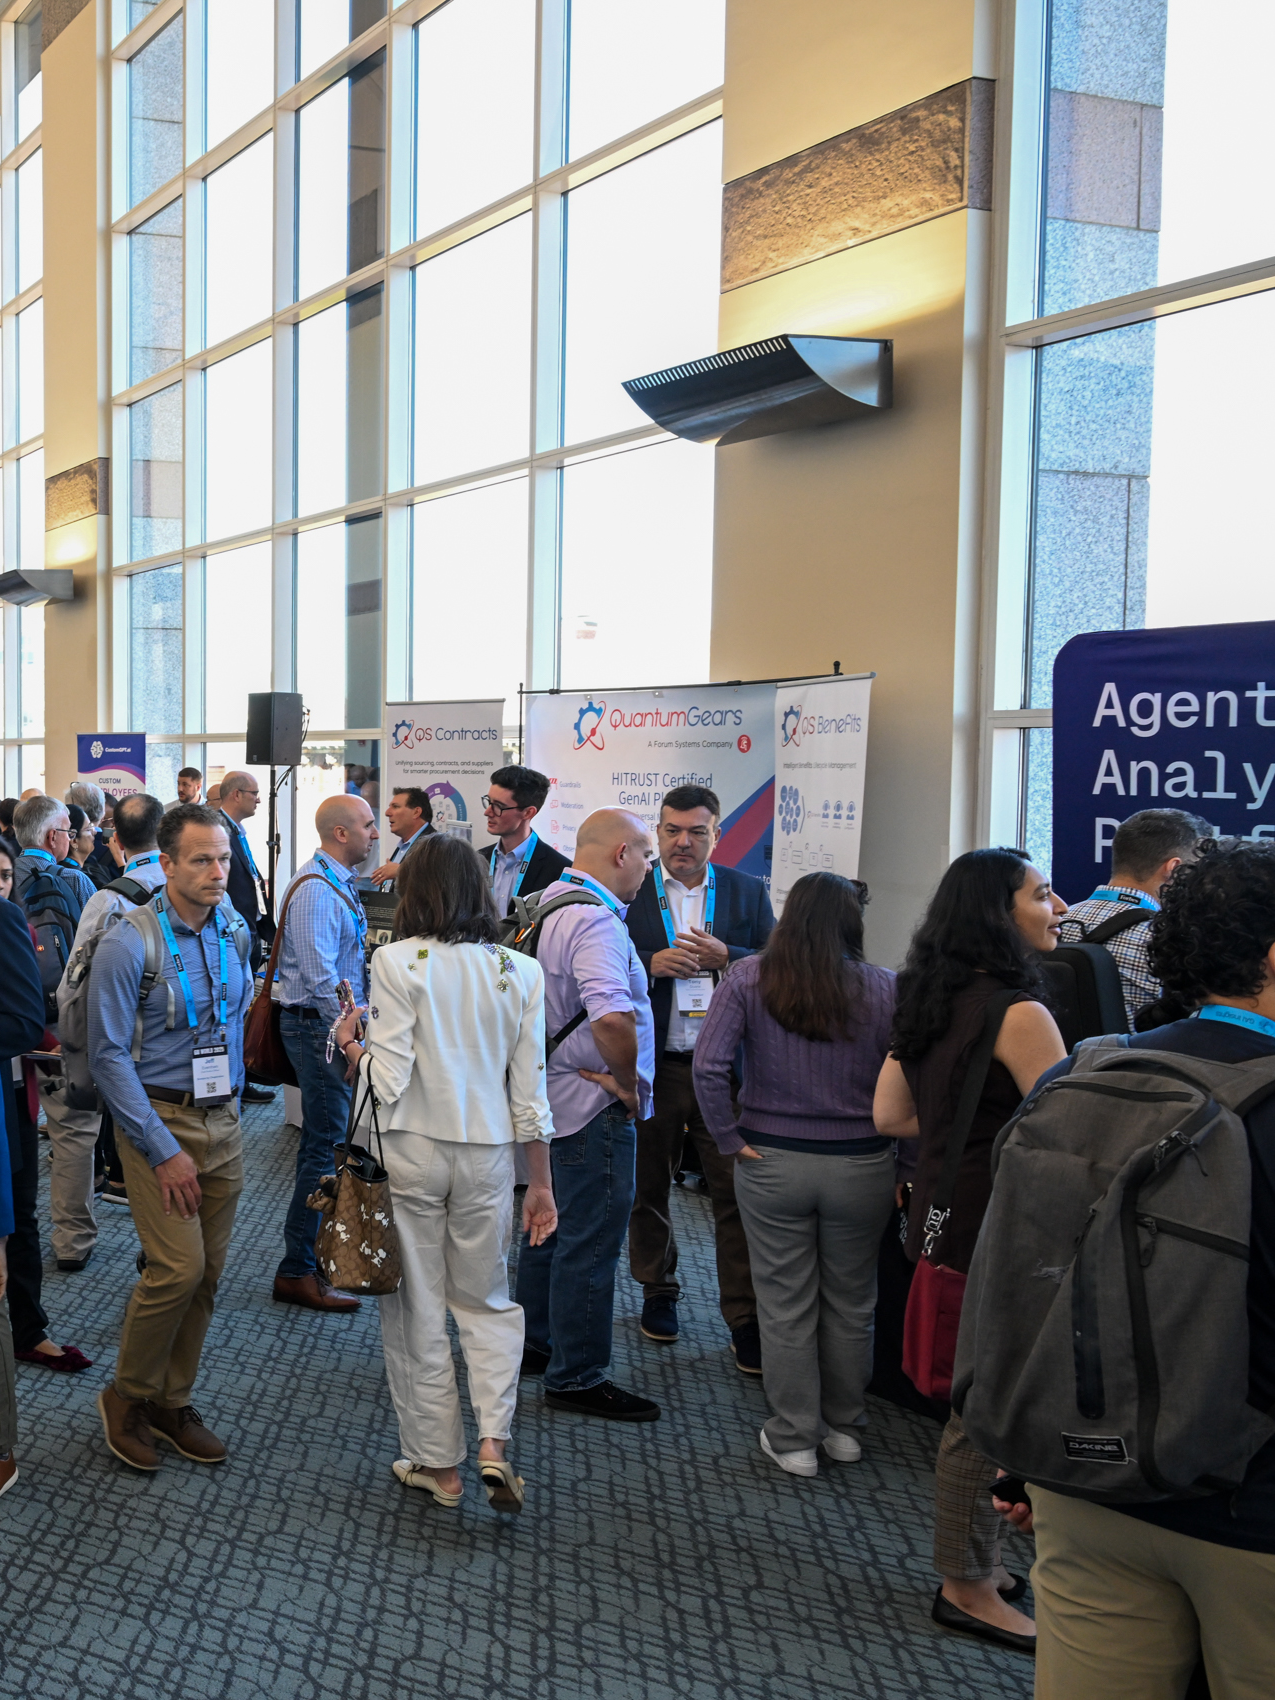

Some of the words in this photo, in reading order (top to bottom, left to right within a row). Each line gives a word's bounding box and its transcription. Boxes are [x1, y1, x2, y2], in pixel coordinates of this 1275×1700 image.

[1092, 681, 1275, 738] Agent
[609, 705, 743, 731] QuantumGears
[817, 713, 861, 735] Benefits
[415, 727, 433, 743] QS
[435, 726, 498, 741] Contracts
[647, 740, 653, 748] A
[654, 740, 673, 748] Forum
[674, 740, 701, 749] Systems
[702, 740, 733, 749] Company
[612, 772, 660, 787] HITRUST
[662, 773, 713, 788] Certified
[1092, 749, 1275, 810] Analy
[101, 788, 137, 797] PLOYEES
[618, 791, 650, 806] GenAI
[636, 811, 656, 820] versal
[562, 824, 577, 833] Privacy
[563, 844, 575, 852] Obser
[1119, 894, 1140, 904] Forbes
